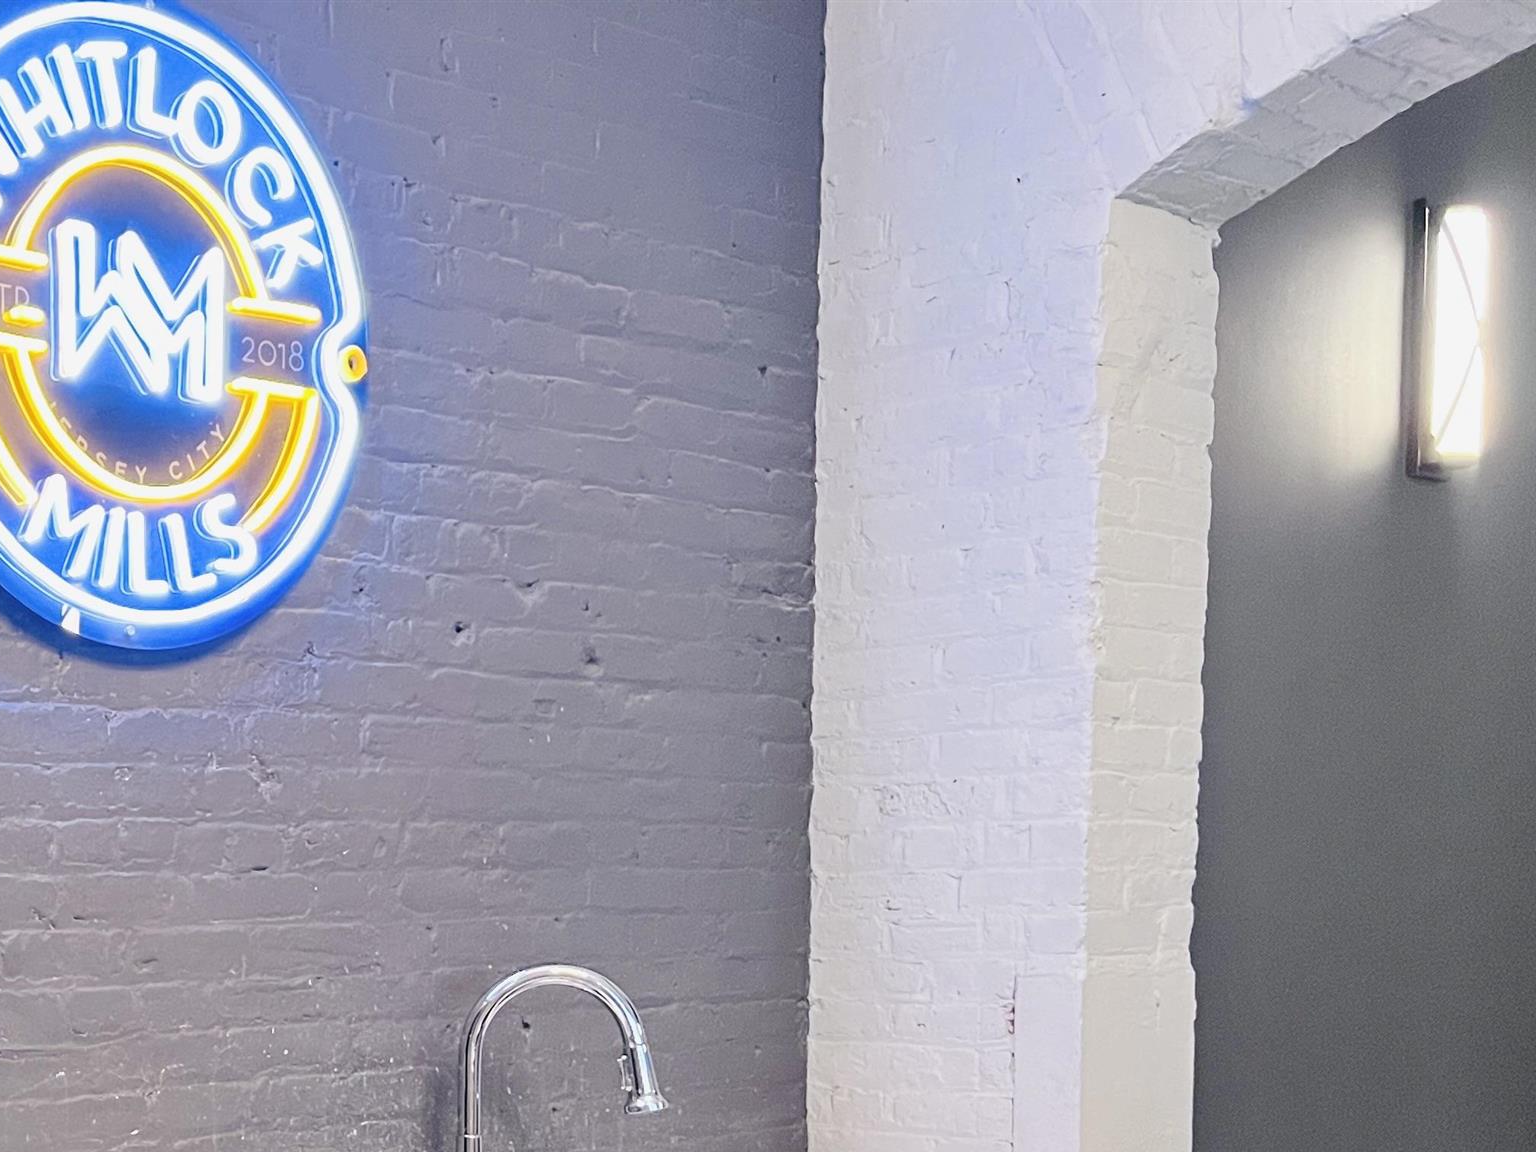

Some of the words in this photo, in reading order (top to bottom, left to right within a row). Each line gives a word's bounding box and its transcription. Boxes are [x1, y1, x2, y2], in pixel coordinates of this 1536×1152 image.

[241, 336, 305, 372] 2018
[50, 401, 148, 484] RSEY
[168, 423, 226, 480] CITY
[24, 473, 259, 595] MILLS
